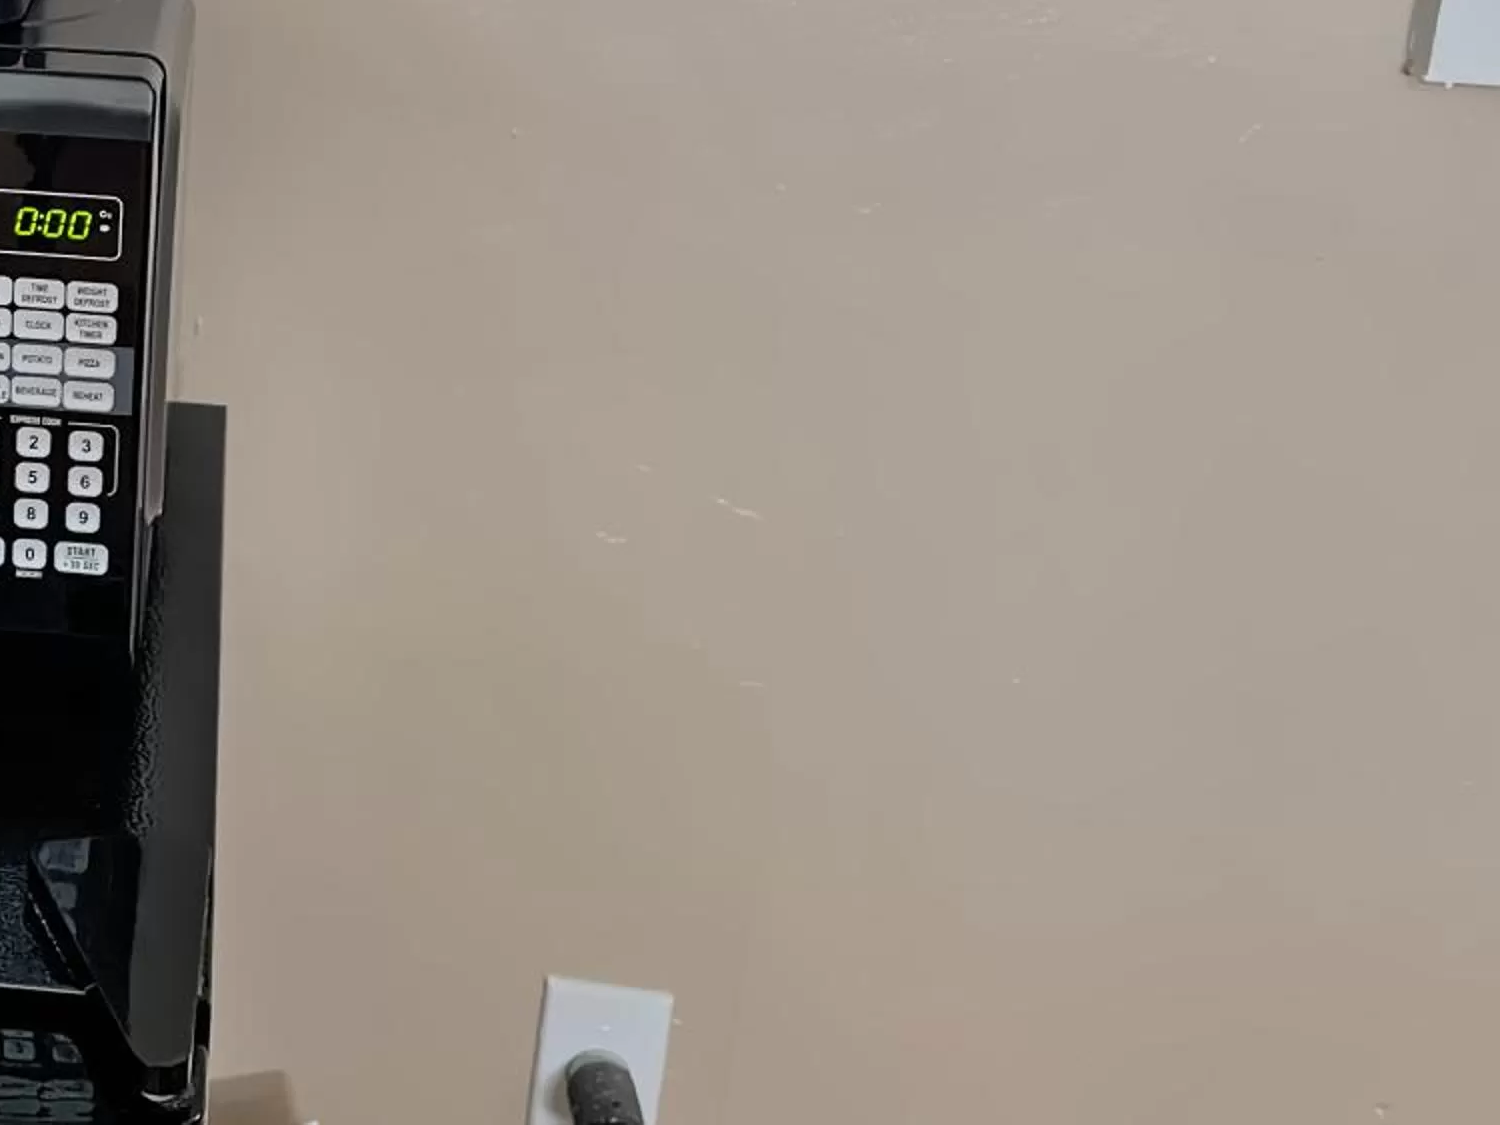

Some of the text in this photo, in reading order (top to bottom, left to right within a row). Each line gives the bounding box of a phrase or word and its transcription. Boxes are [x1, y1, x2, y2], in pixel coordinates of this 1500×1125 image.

[14, 206, 93, 240] 0:00
[21, 294, 58, 305] DEFROST
[73, 298, 111, 308] DEFROST
[25, 320, 51, 330] CLOCK
[29, 435, 39, 450] 2
[81, 439, 91, 453] 3
[28, 470, 38, 484] 5
[80, 475, 90, 489] 6
[26, 506, 36, 520] 8
[78, 510, 89, 524] 9
[25, 547, 35, 561] 0
[66, 546, 97, 557] START
